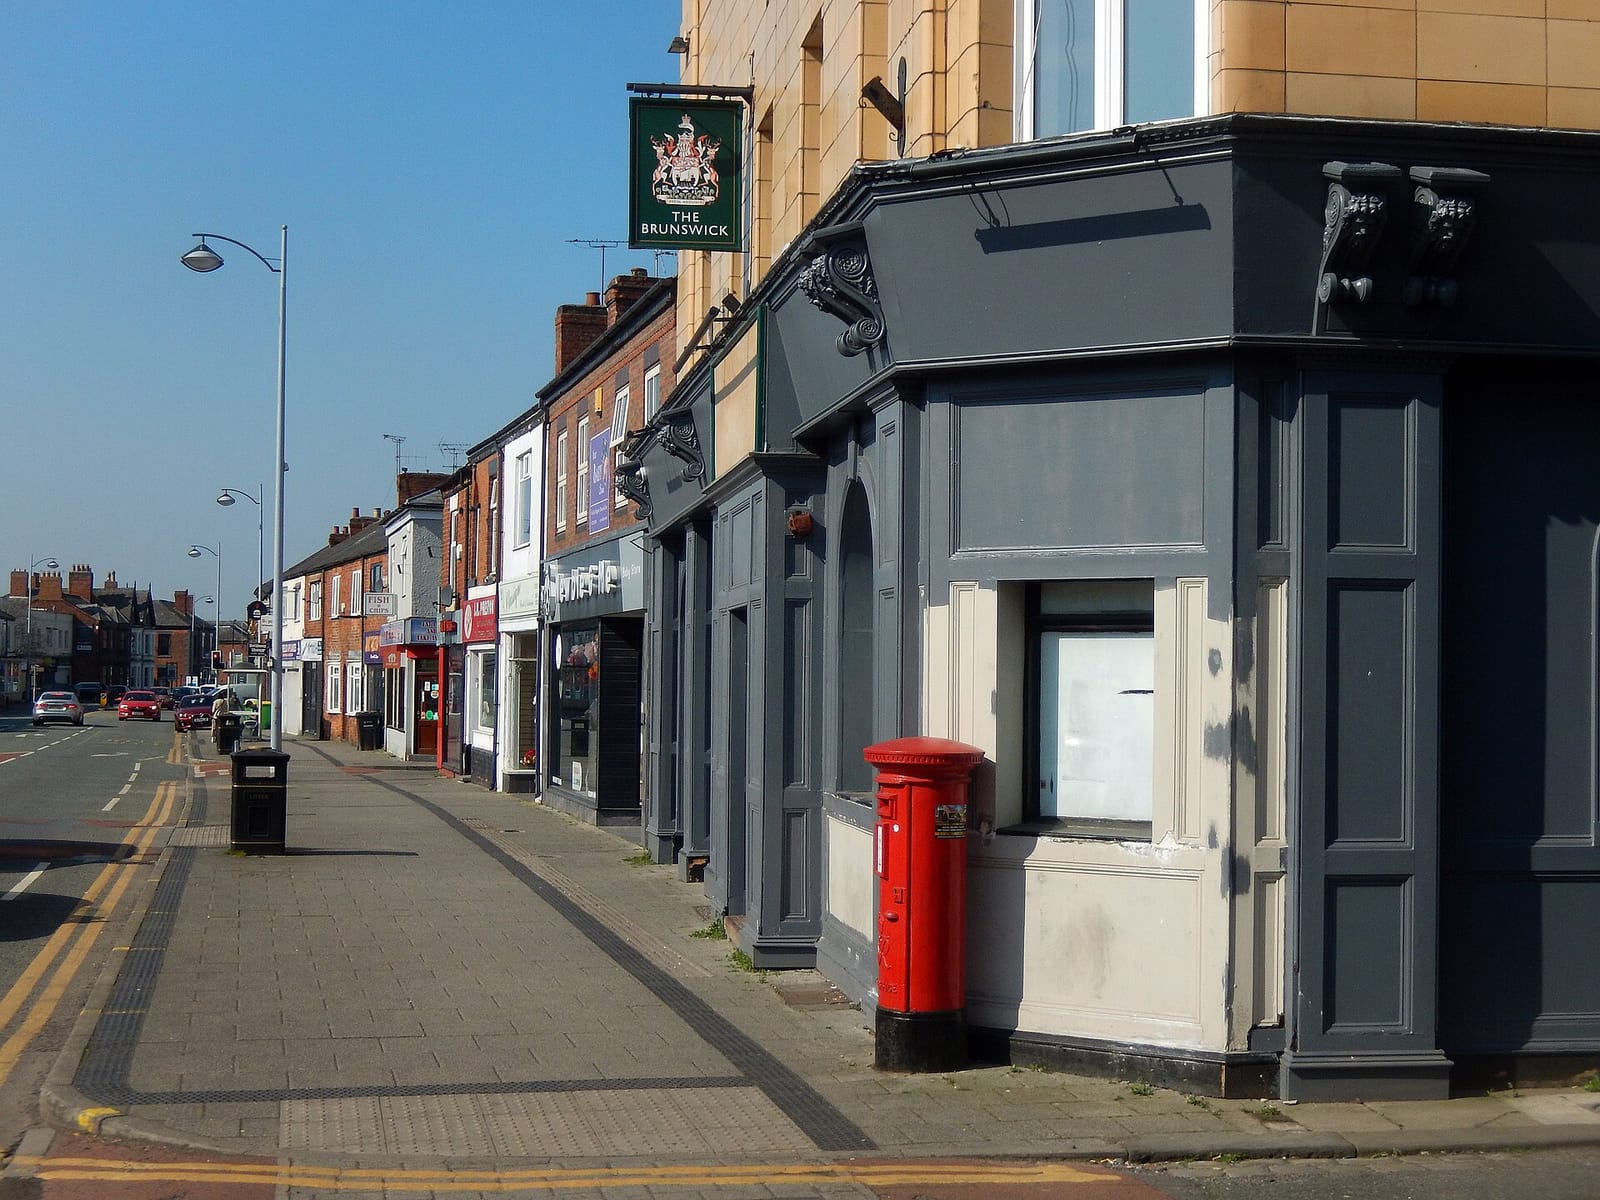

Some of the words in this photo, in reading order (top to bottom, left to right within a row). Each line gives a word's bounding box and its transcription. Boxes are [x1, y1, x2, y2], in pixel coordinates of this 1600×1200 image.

[671, 211, 700, 222] THE
[641, 223, 729, 237] BRUNSWICK
[368, 596, 389, 604] FISH
